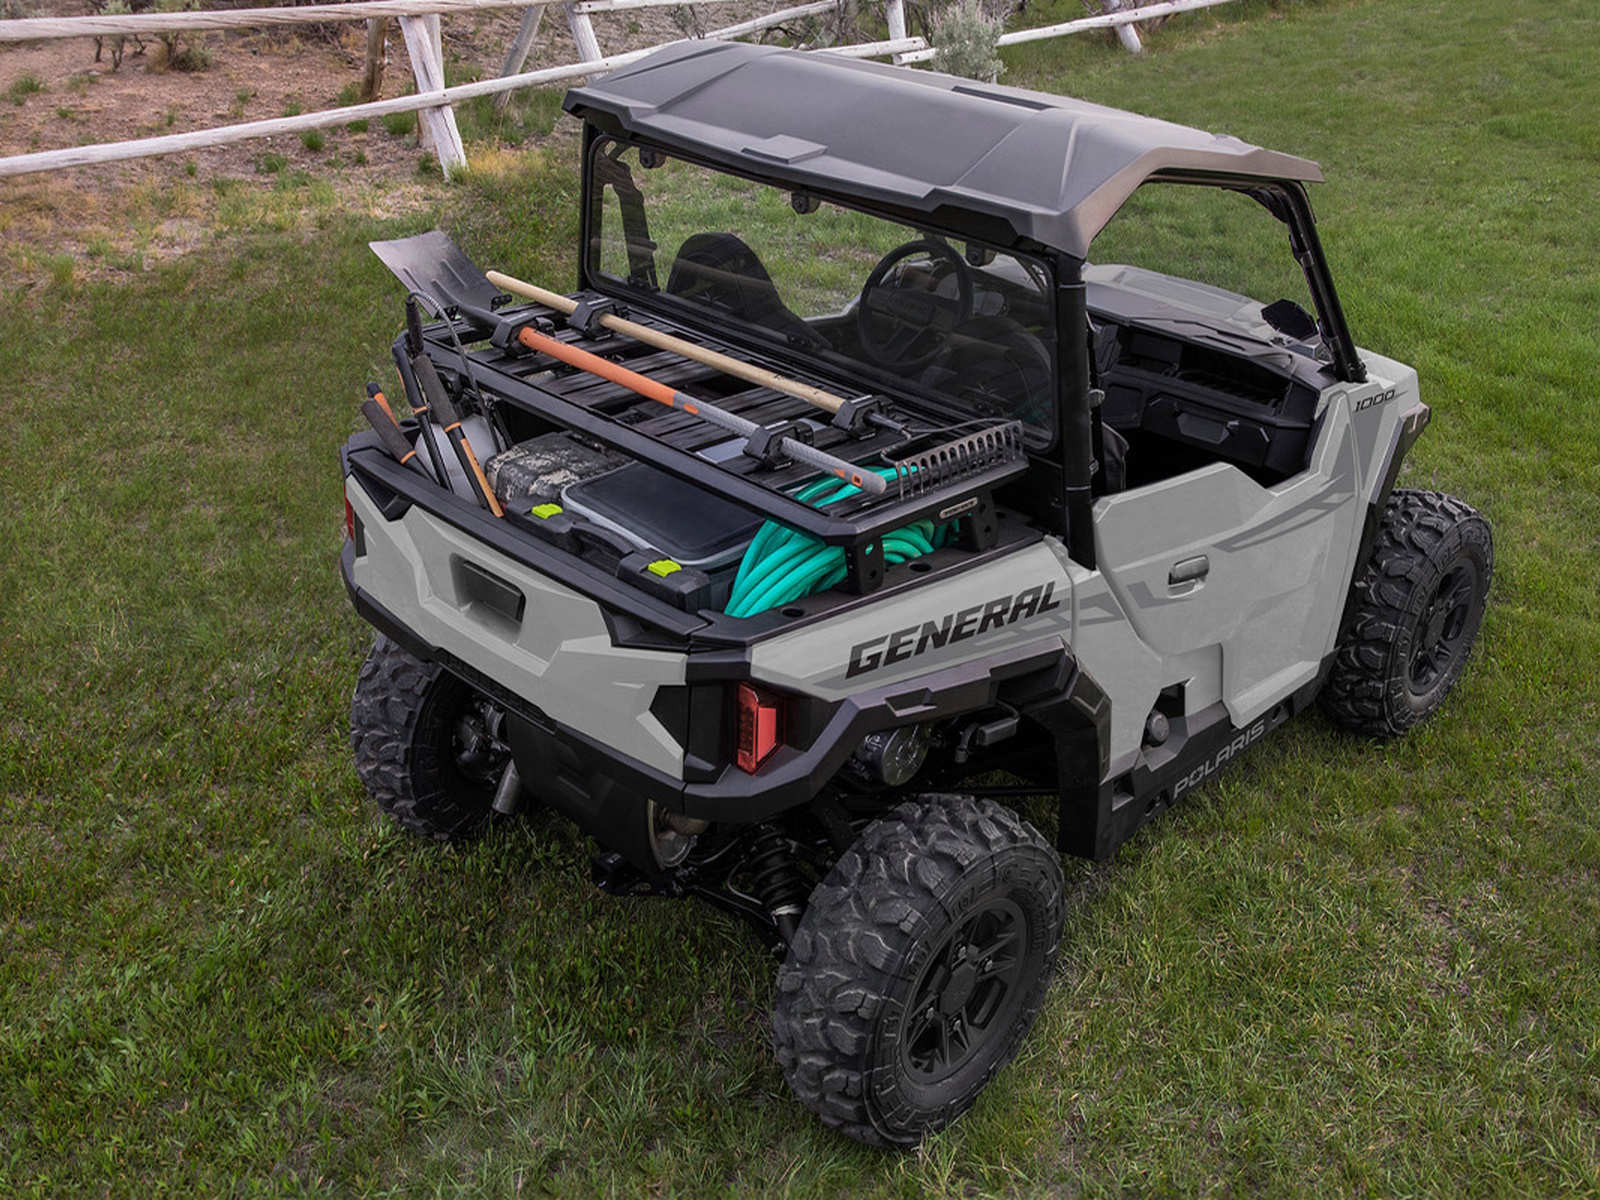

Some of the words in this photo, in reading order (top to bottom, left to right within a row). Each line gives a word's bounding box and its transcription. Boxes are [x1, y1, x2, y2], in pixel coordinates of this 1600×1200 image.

[1355, 389, 1395, 412] 1000
[845, 581, 1060, 679] GENERAL
[1173, 719, 1265, 799] POLARIS
